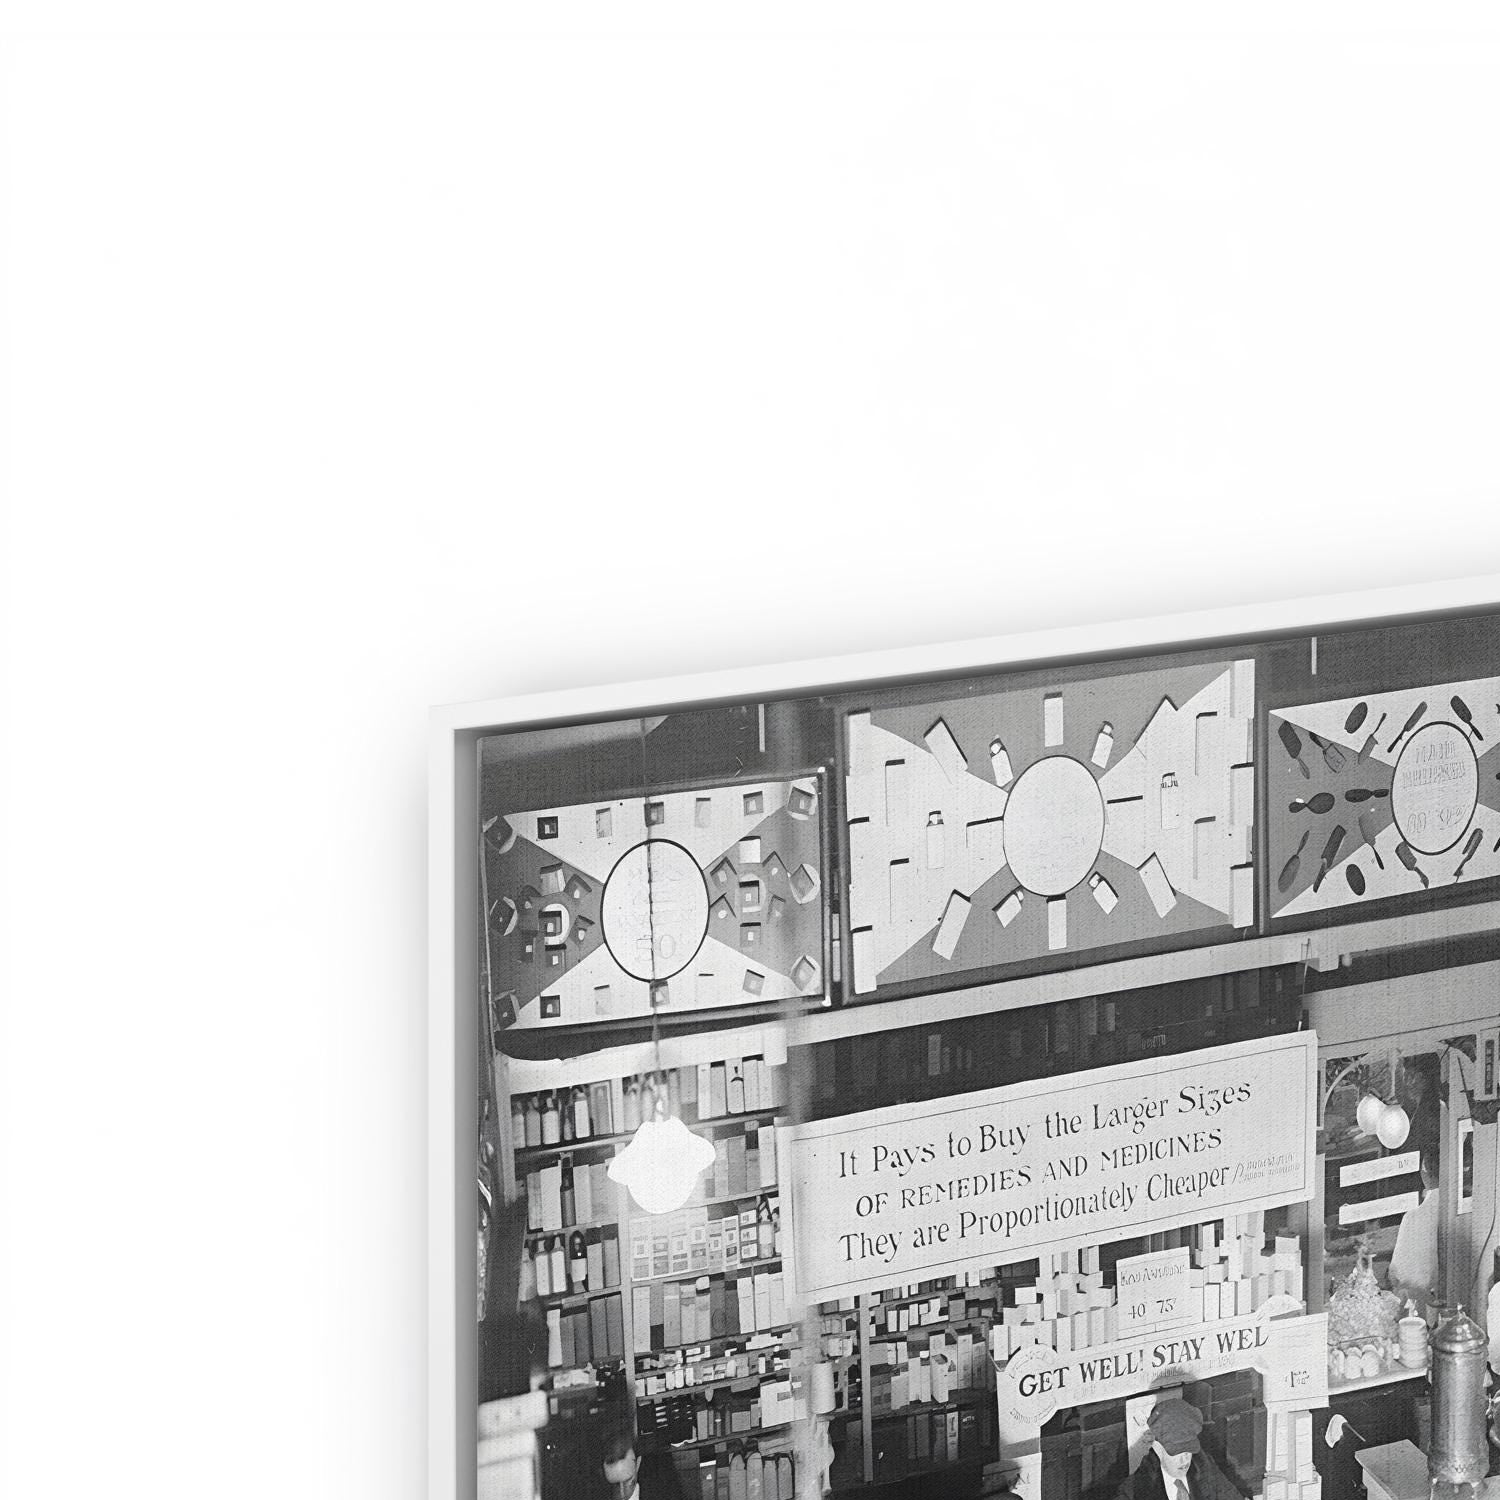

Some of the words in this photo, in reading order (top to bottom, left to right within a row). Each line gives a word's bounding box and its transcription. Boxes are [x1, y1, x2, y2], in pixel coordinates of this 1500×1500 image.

[839, 1150, 858, 1178] It
[872, 1143, 936, 1177] Pays
[948, 1131, 972, 1158] to
[979, 1124, 1031, 1156] Buy
[1045, 1112, 1082, 1138] the
[1093, 1097, 1169, 1134] Larger
[1178, 1083, 1251, 1116] Sizes
[855, 1192, 889, 1217] OF
[901, 1165, 1032, 1209] REMEDIES
[1042, 1155, 1088, 1184] AND
[1101, 1128, 1222, 1171] MEDICINES
[838, 1231, 902, 1263] They
[912, 1222, 950, 1248] are
[959, 1182, 1138, 1239] Proportionately
[1147, 1165, 1230, 1202] Cheaper
[1018, 1366, 1070, 1397] GET
[1079, 1349, 1144, 1383] WELL!
[1151, 1337, 1205, 1368] STAY
